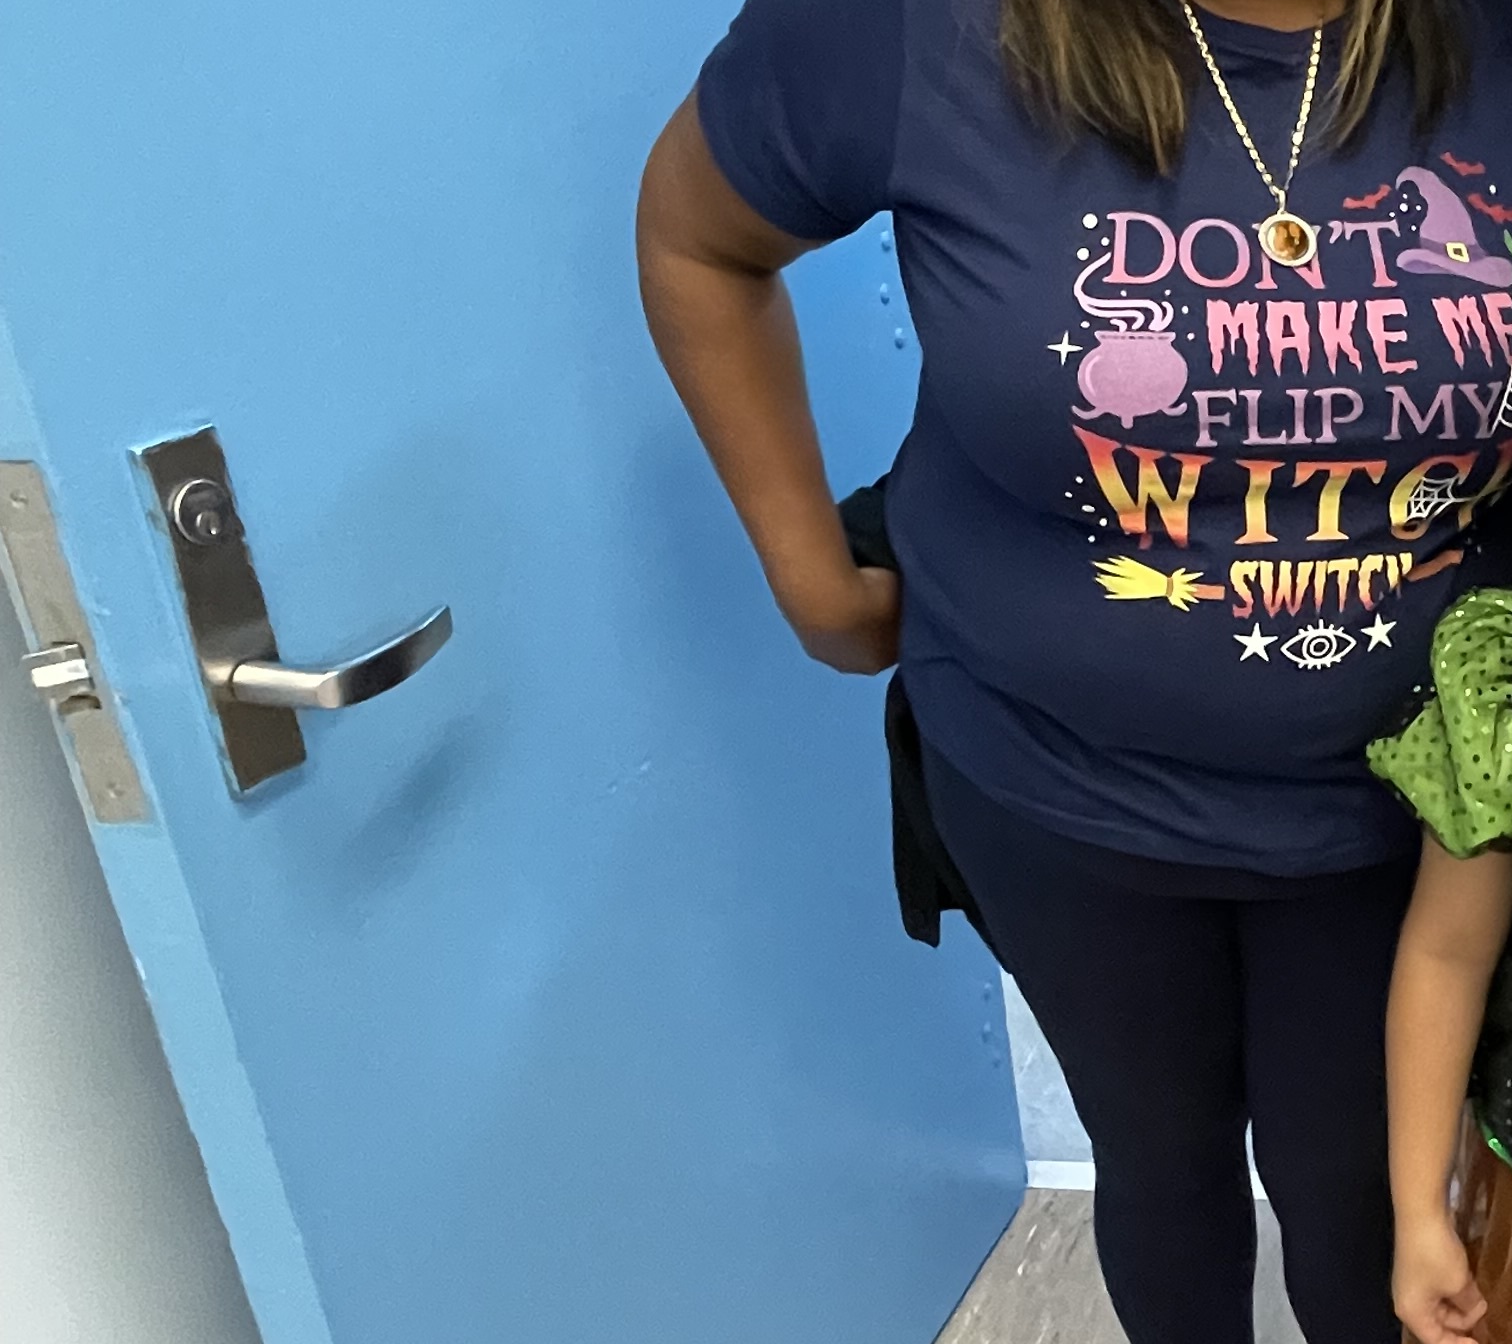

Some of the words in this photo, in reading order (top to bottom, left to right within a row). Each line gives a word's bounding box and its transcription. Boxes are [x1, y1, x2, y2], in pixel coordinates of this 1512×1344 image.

[1103, 211, 1400, 291] DON'T
[1205, 297, 1419, 377] MAKE
[1191, 388, 1364, 448] FLIP
[1383, 381, 1503, 441] MY
